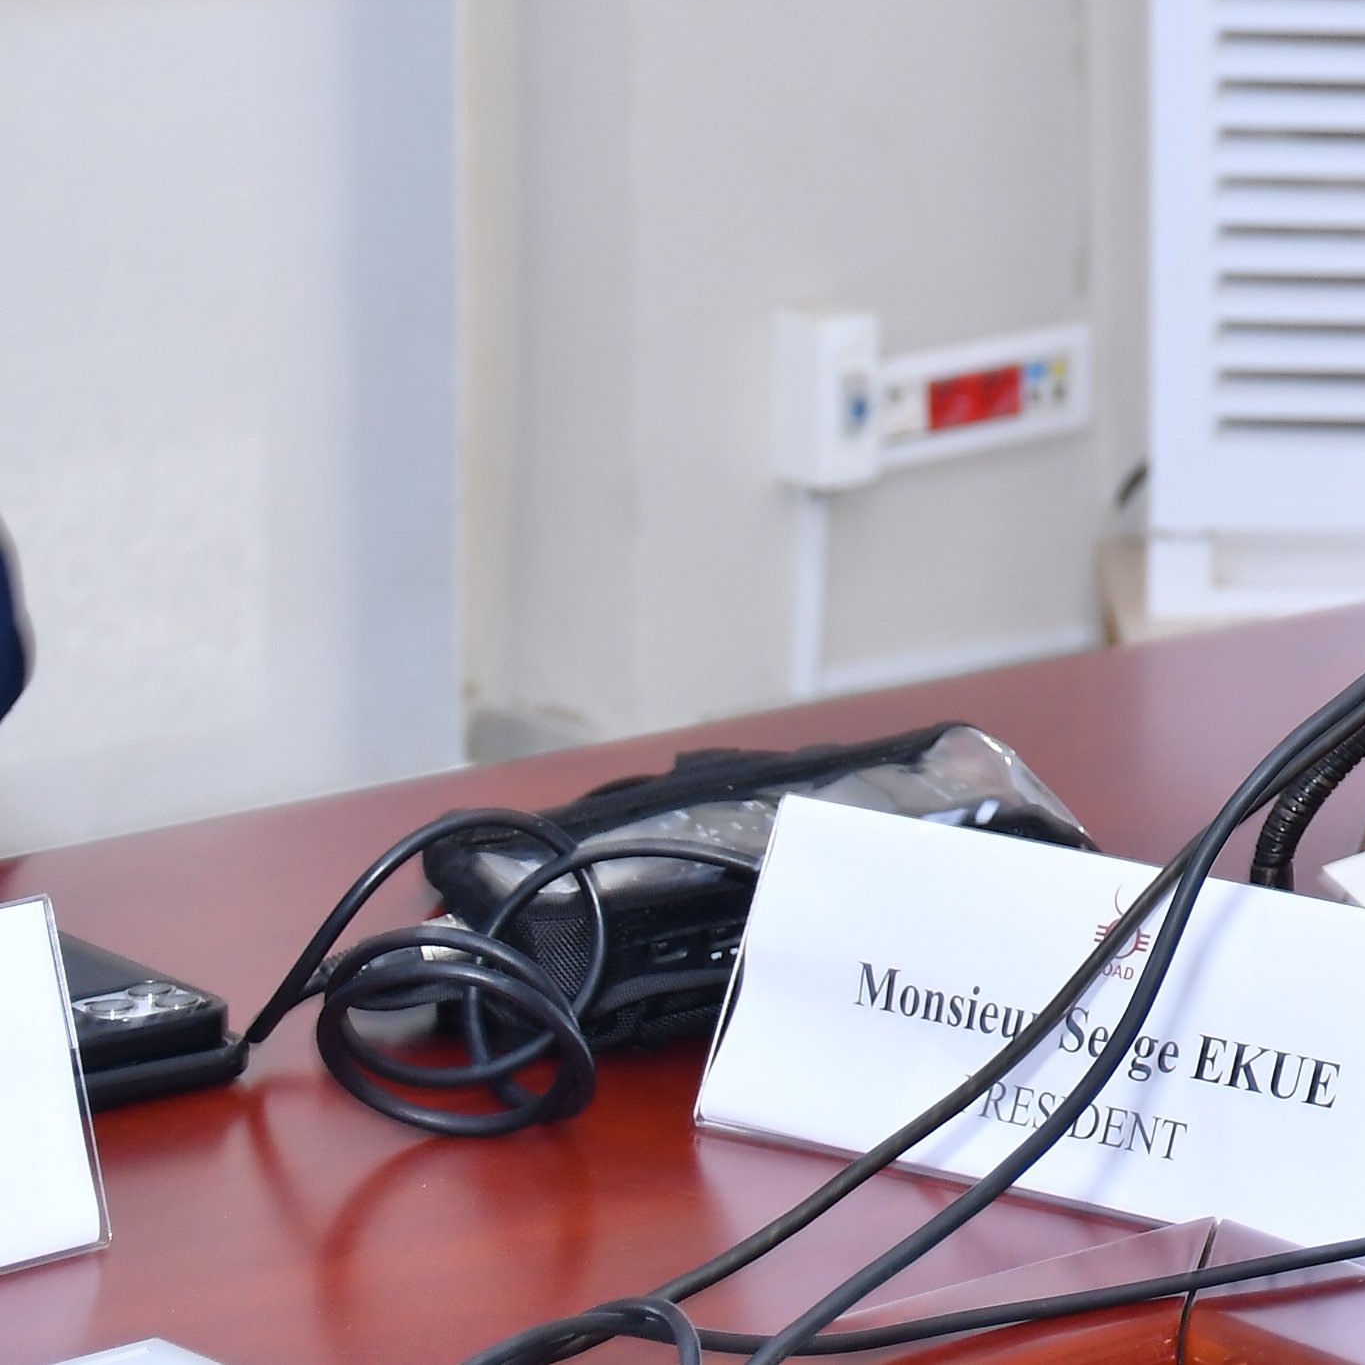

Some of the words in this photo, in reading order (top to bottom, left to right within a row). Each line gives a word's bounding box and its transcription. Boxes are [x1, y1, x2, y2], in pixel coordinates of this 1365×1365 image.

[1102, 961, 1135, 981] OAD
[1058, 1006, 1180, 1082] Sege
[1190, 1033, 1341, 1109] EKUE
[963, 1074, 1188, 1161] RESDENT
